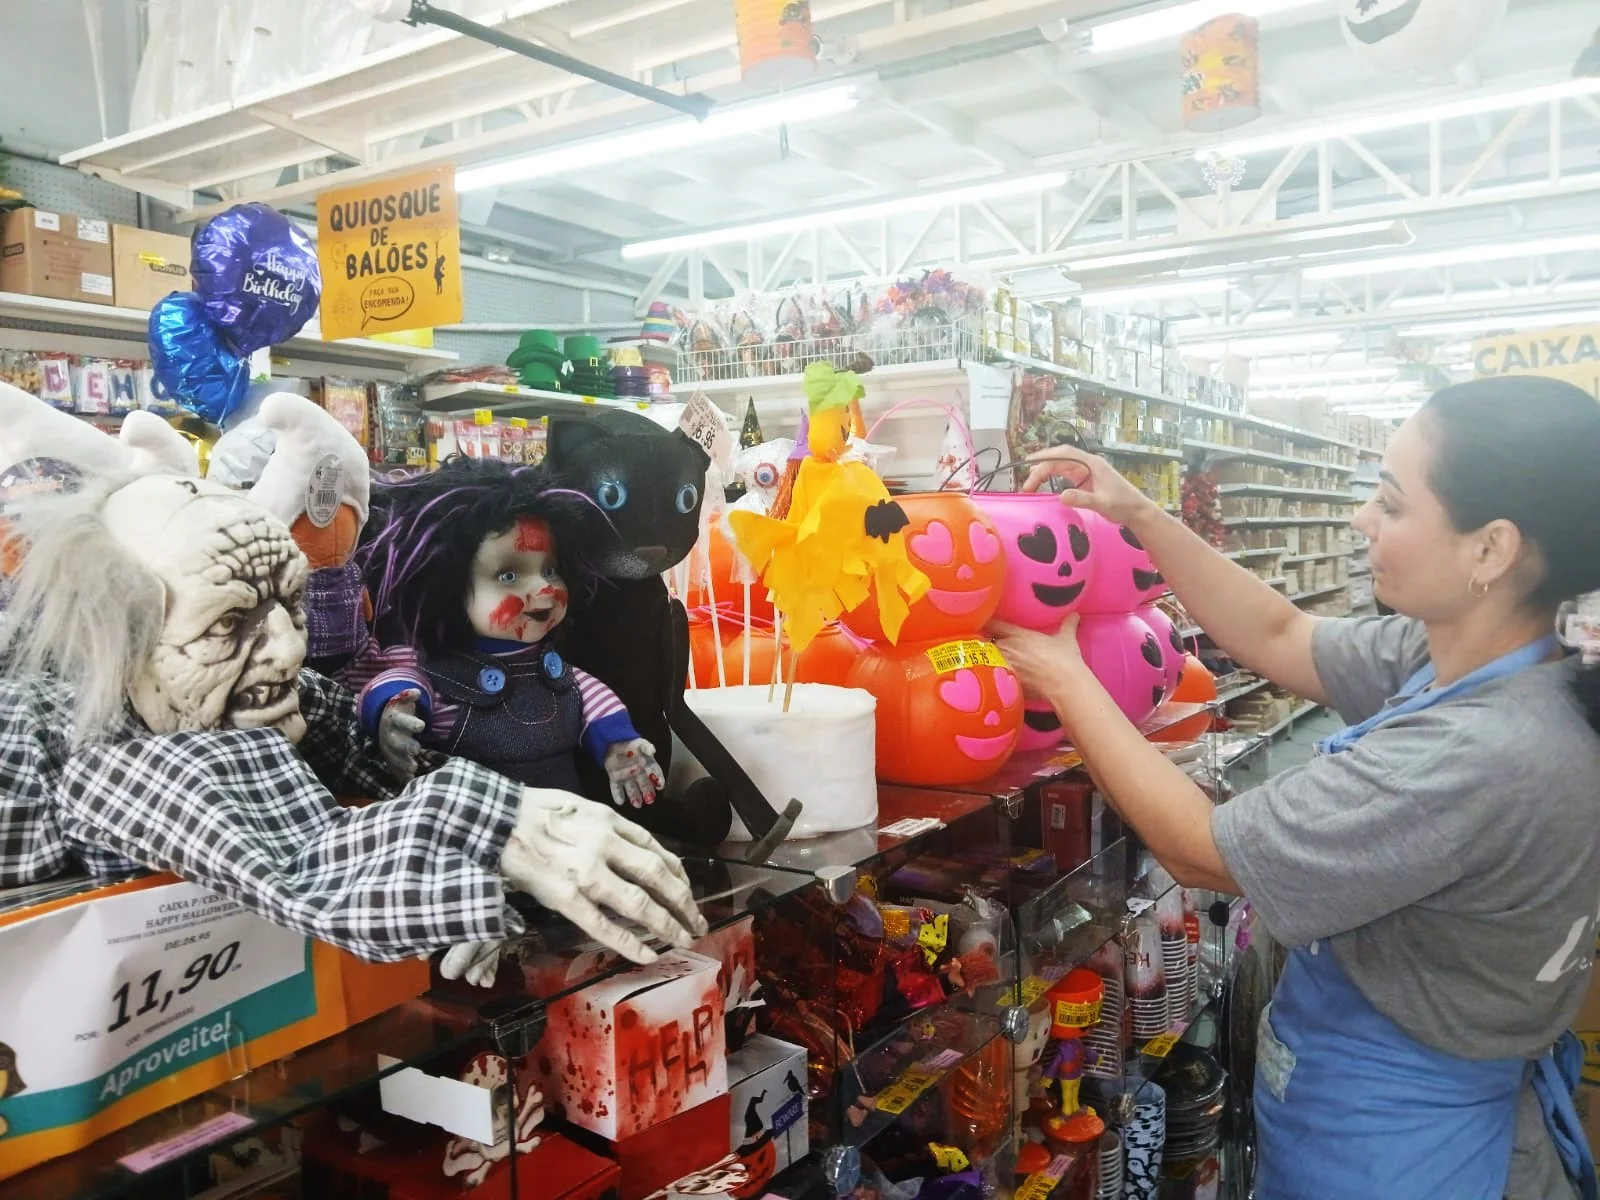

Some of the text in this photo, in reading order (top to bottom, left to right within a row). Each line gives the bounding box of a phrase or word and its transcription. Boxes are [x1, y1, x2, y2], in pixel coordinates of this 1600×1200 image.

[330, 183, 441, 232] QUIOSQUE
[370, 227, 388, 247] DE
[253, 251, 306, 291] Happy
[346, 241, 428, 280] BALÕES
[242, 272, 302, 316] Birthday
[145, 915, 180, 929] HAPPY
[107, 940, 241, 1033] 11,90
[100, 1010, 232, 1101] Aproveite!
